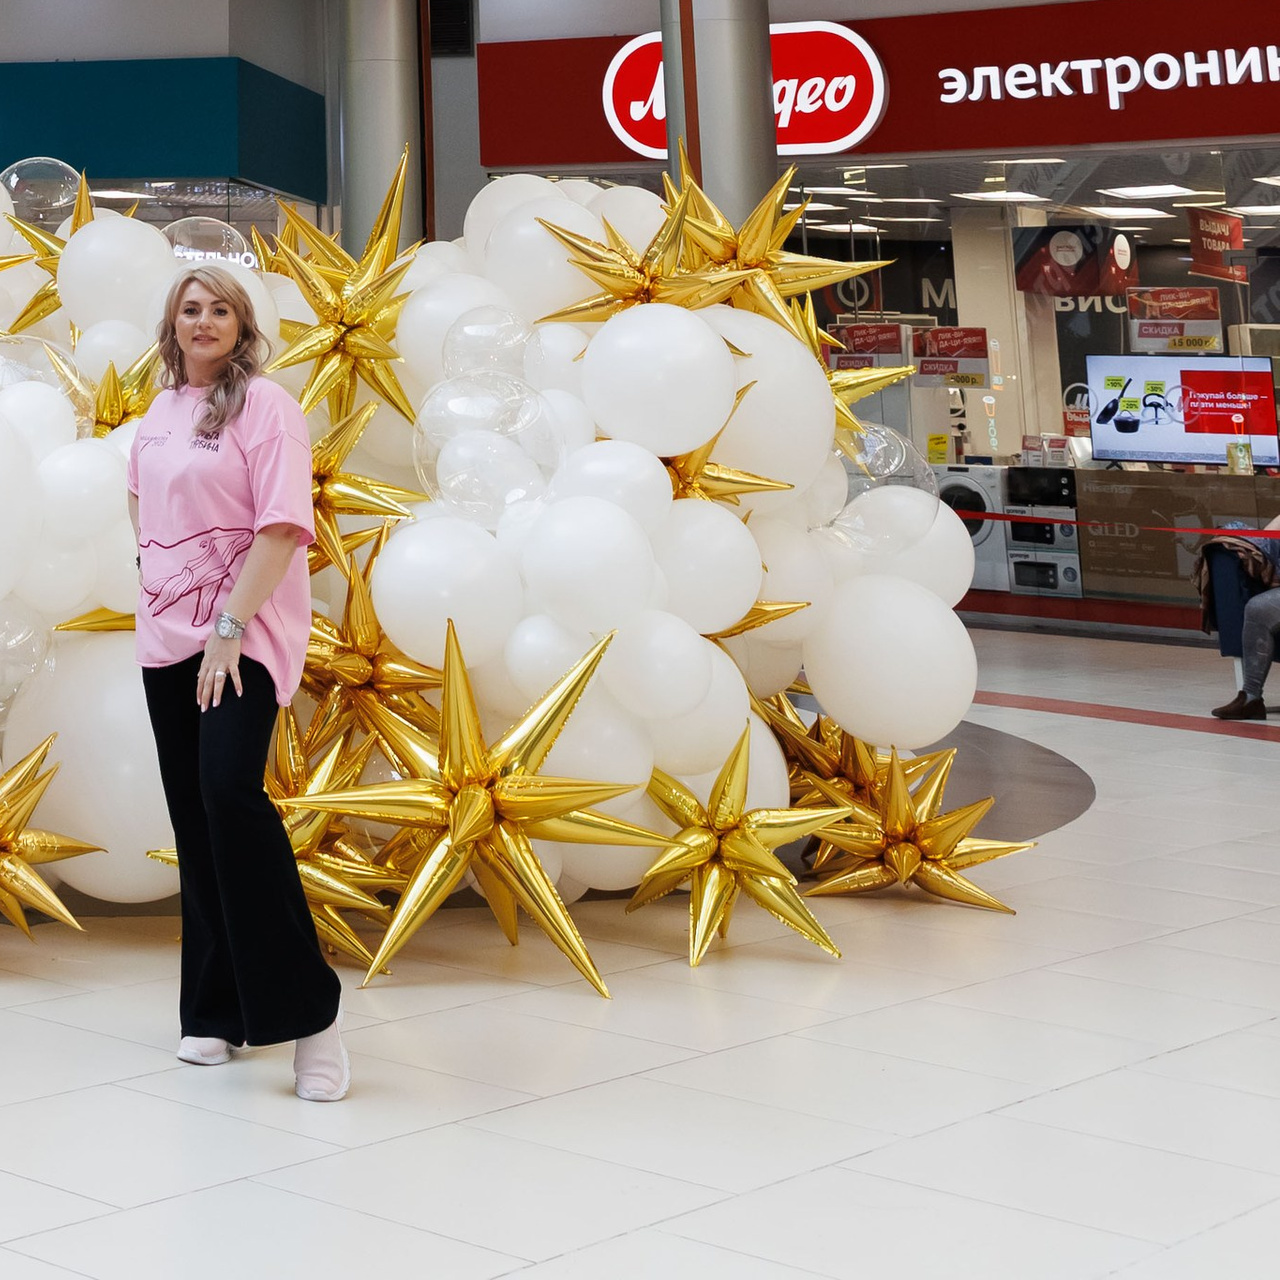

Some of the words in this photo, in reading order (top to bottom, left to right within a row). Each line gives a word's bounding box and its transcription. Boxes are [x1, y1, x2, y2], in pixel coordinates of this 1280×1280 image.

[1142, 326, 1180, 335] СКИДКА
[839, 359, 871, 369] СКИДКА
[923, 363, 955, 372] СКИДКА
